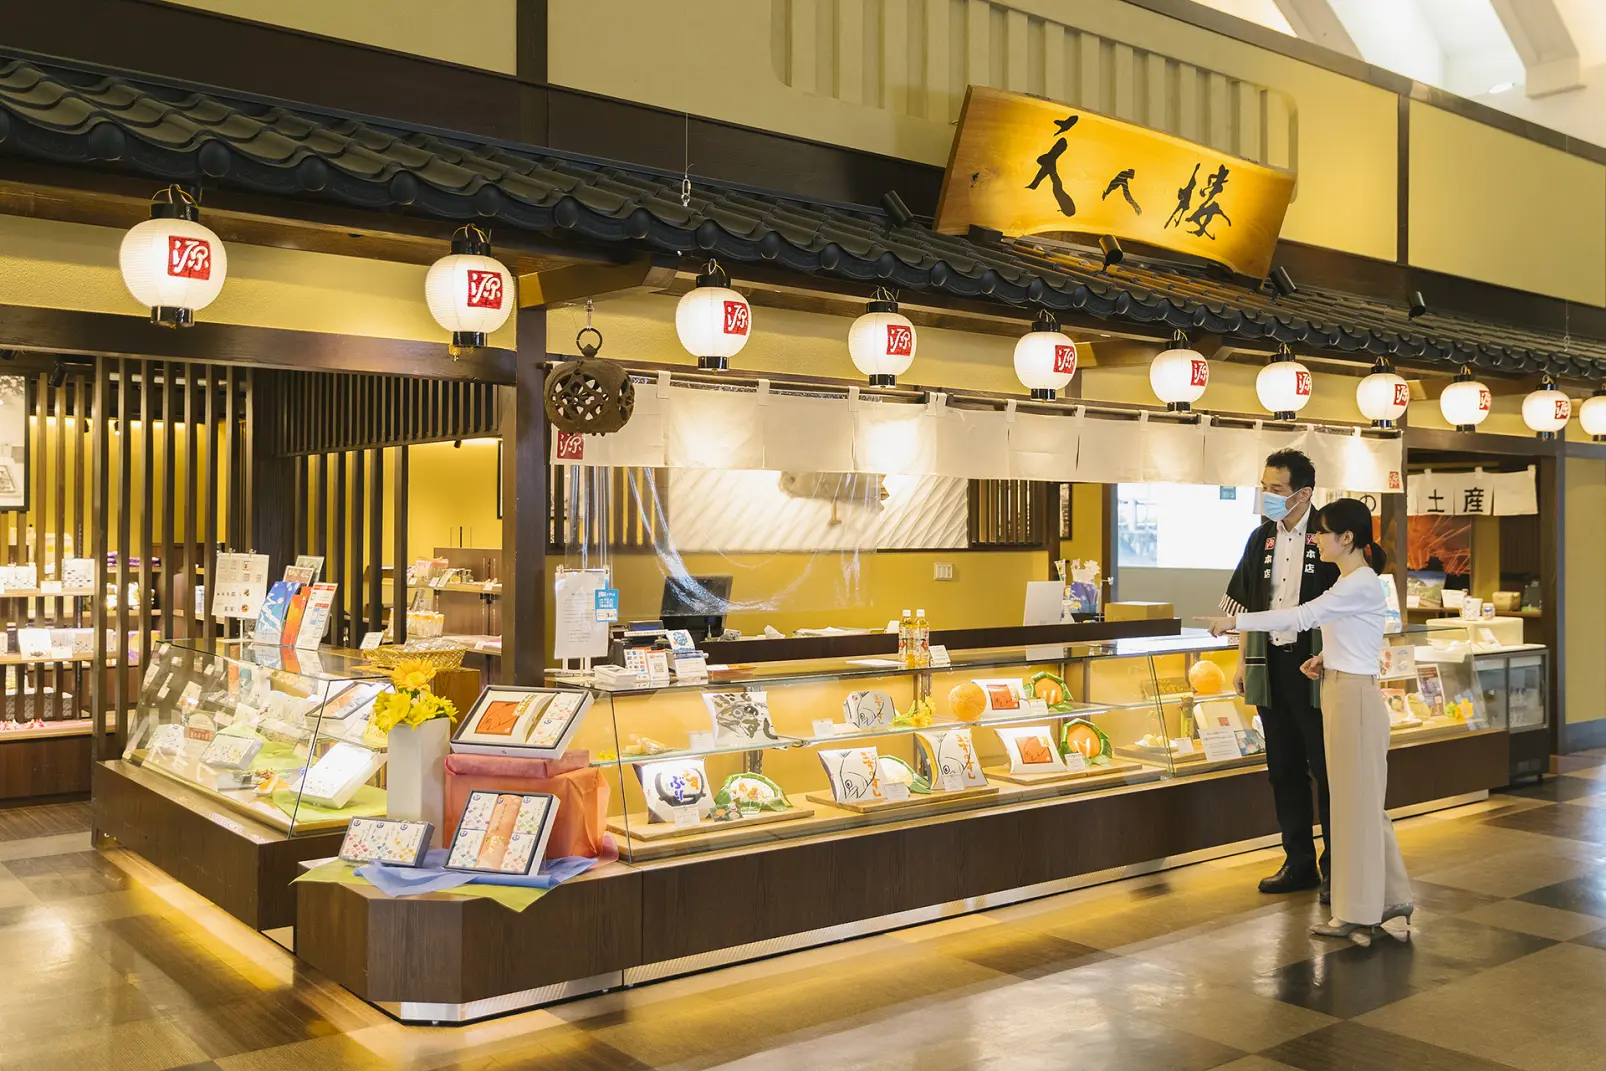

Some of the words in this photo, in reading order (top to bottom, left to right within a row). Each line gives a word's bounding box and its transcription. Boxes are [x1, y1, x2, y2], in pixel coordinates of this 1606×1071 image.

[171, 238, 210, 276] 源
[470, 272, 502, 305] 源
[726, 303, 748, 332] 源
[888, 327, 912, 354] 源
[1056, 347, 1075, 373] 源
[1192, 362, 1208, 385] 源
[560, 433, 582, 457] 源
